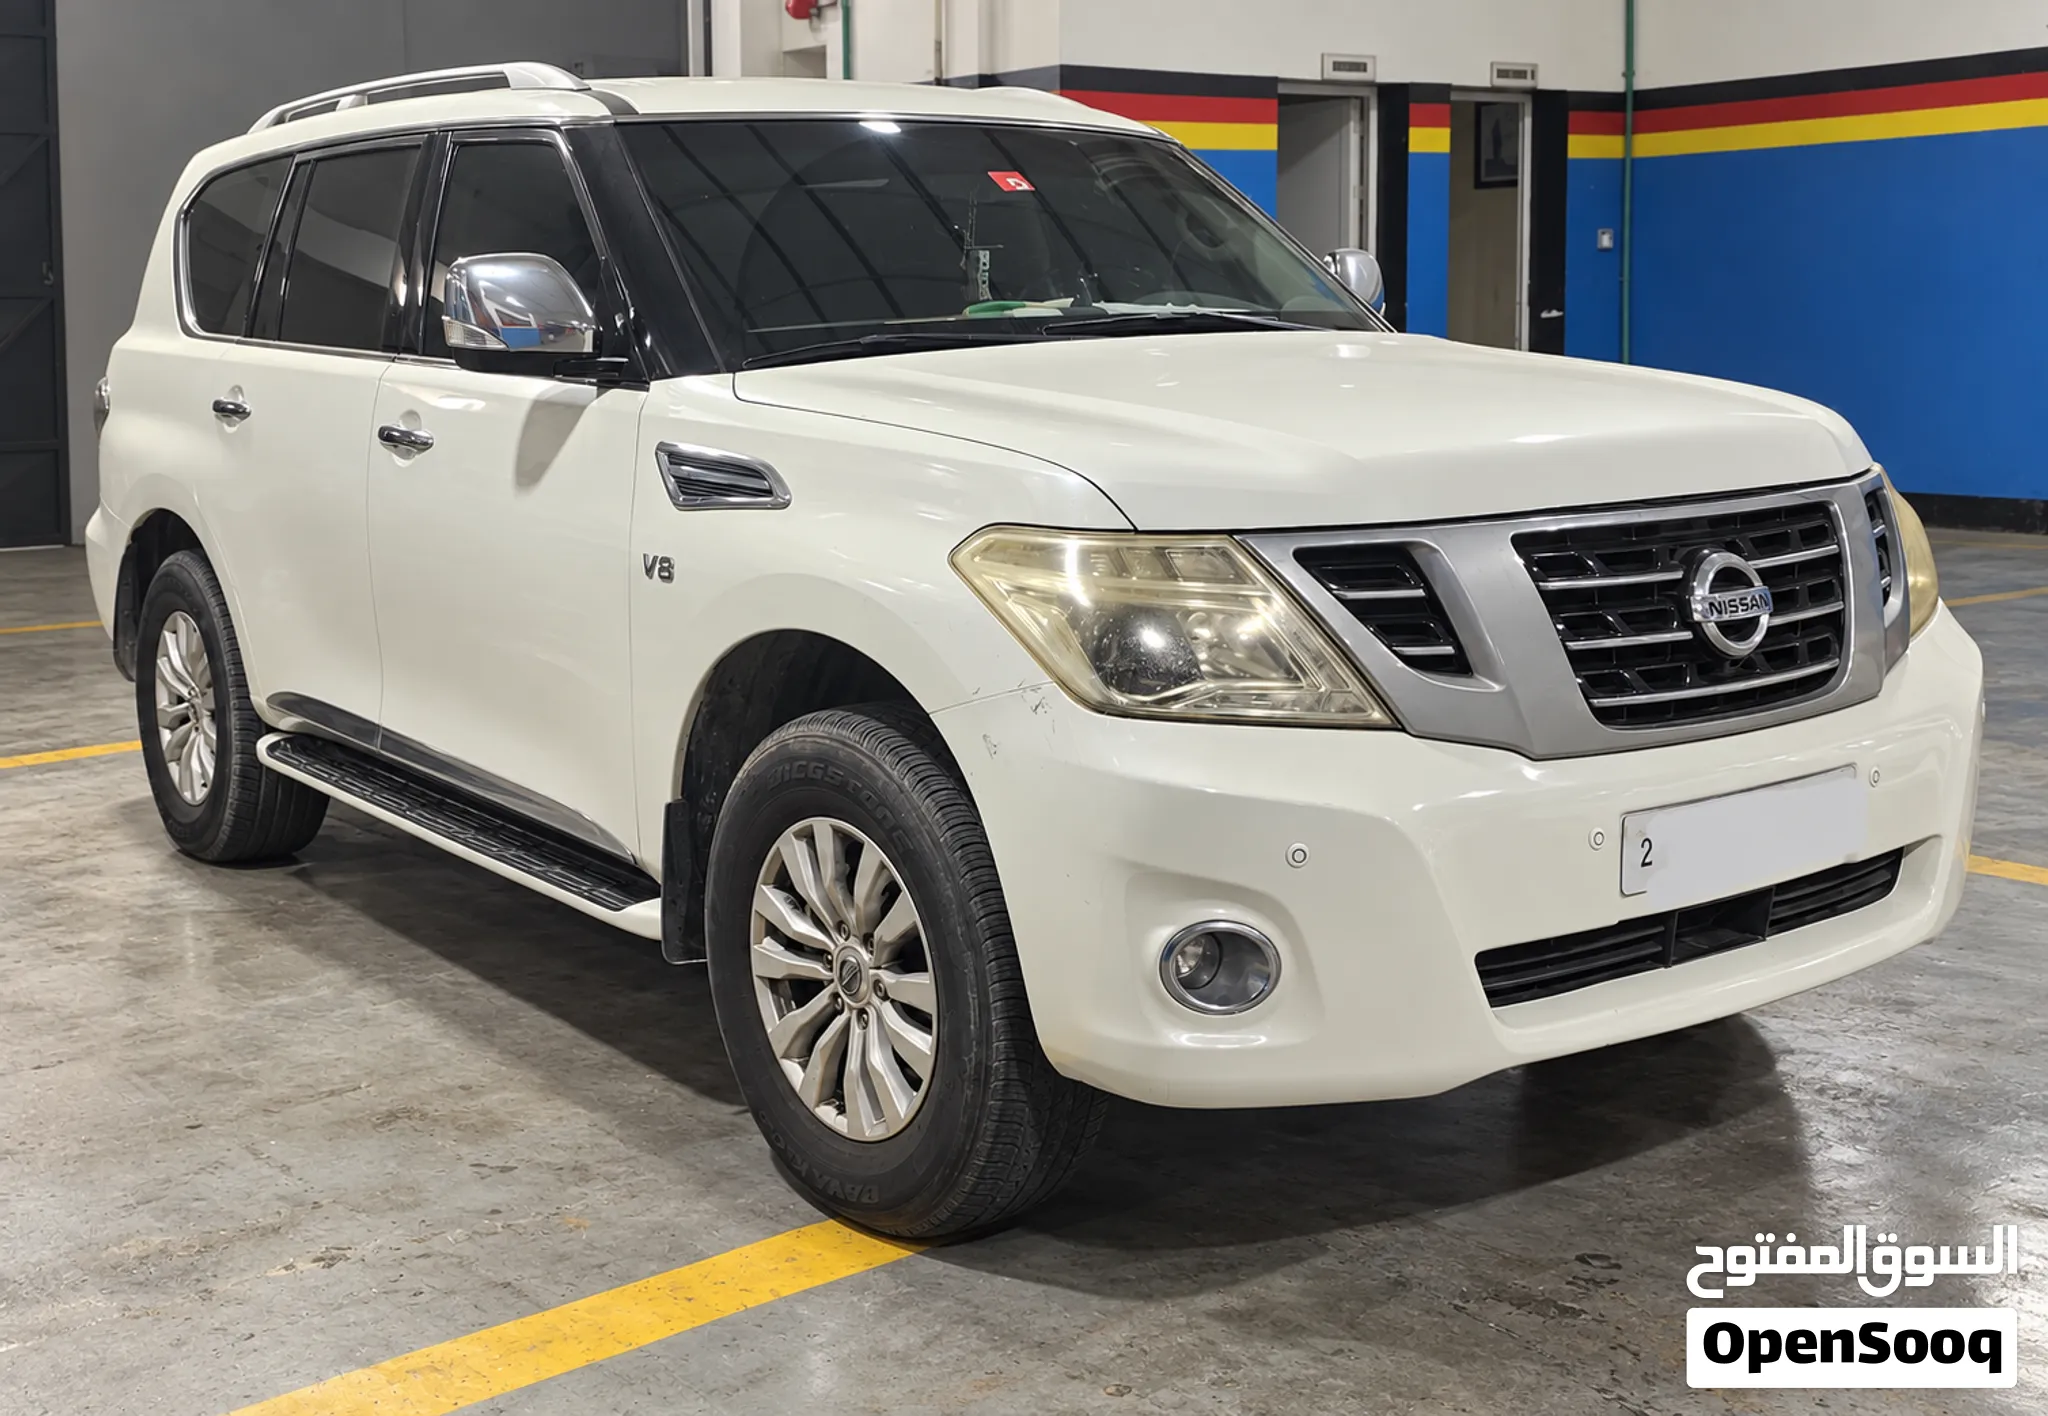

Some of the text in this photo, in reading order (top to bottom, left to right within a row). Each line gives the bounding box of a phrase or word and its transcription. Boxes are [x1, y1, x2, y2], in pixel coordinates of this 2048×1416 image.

[642, 553, 675, 584] V8
[1707, 592, 1772, 617] NISSAN
[1640, 837, 1653, 868] 2
